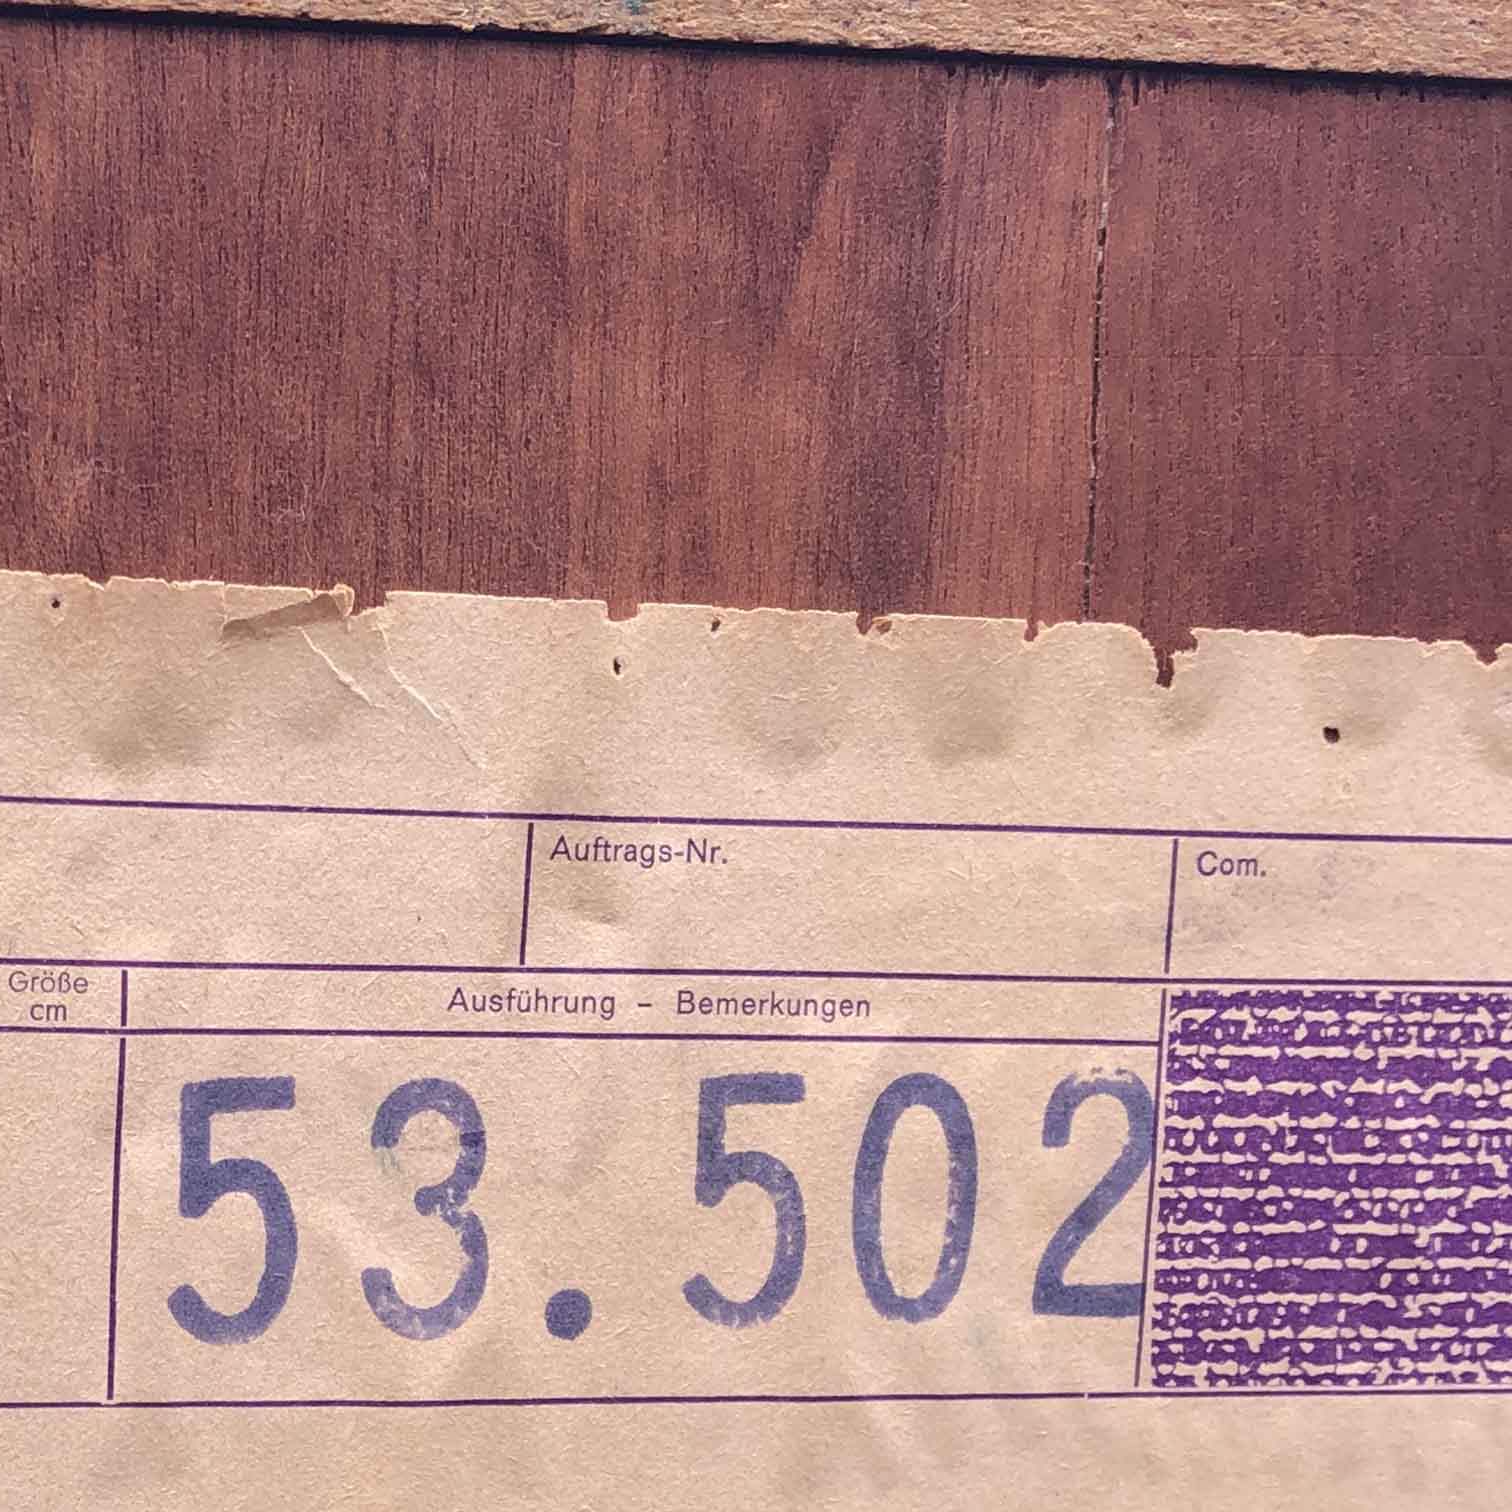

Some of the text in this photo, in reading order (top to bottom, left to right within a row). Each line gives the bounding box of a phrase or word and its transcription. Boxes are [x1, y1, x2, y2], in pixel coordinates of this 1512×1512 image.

[548, 834, 729, 869] Auftrags-Nr.
[1195, 850, 1268, 878] Com.
[7, 970, 89, 995] Größe
[29, 1003, 68, 1022] cm
[446, 986, 617, 1021] Ausführung
[675, 990, 872, 1023] Bemerkungen
